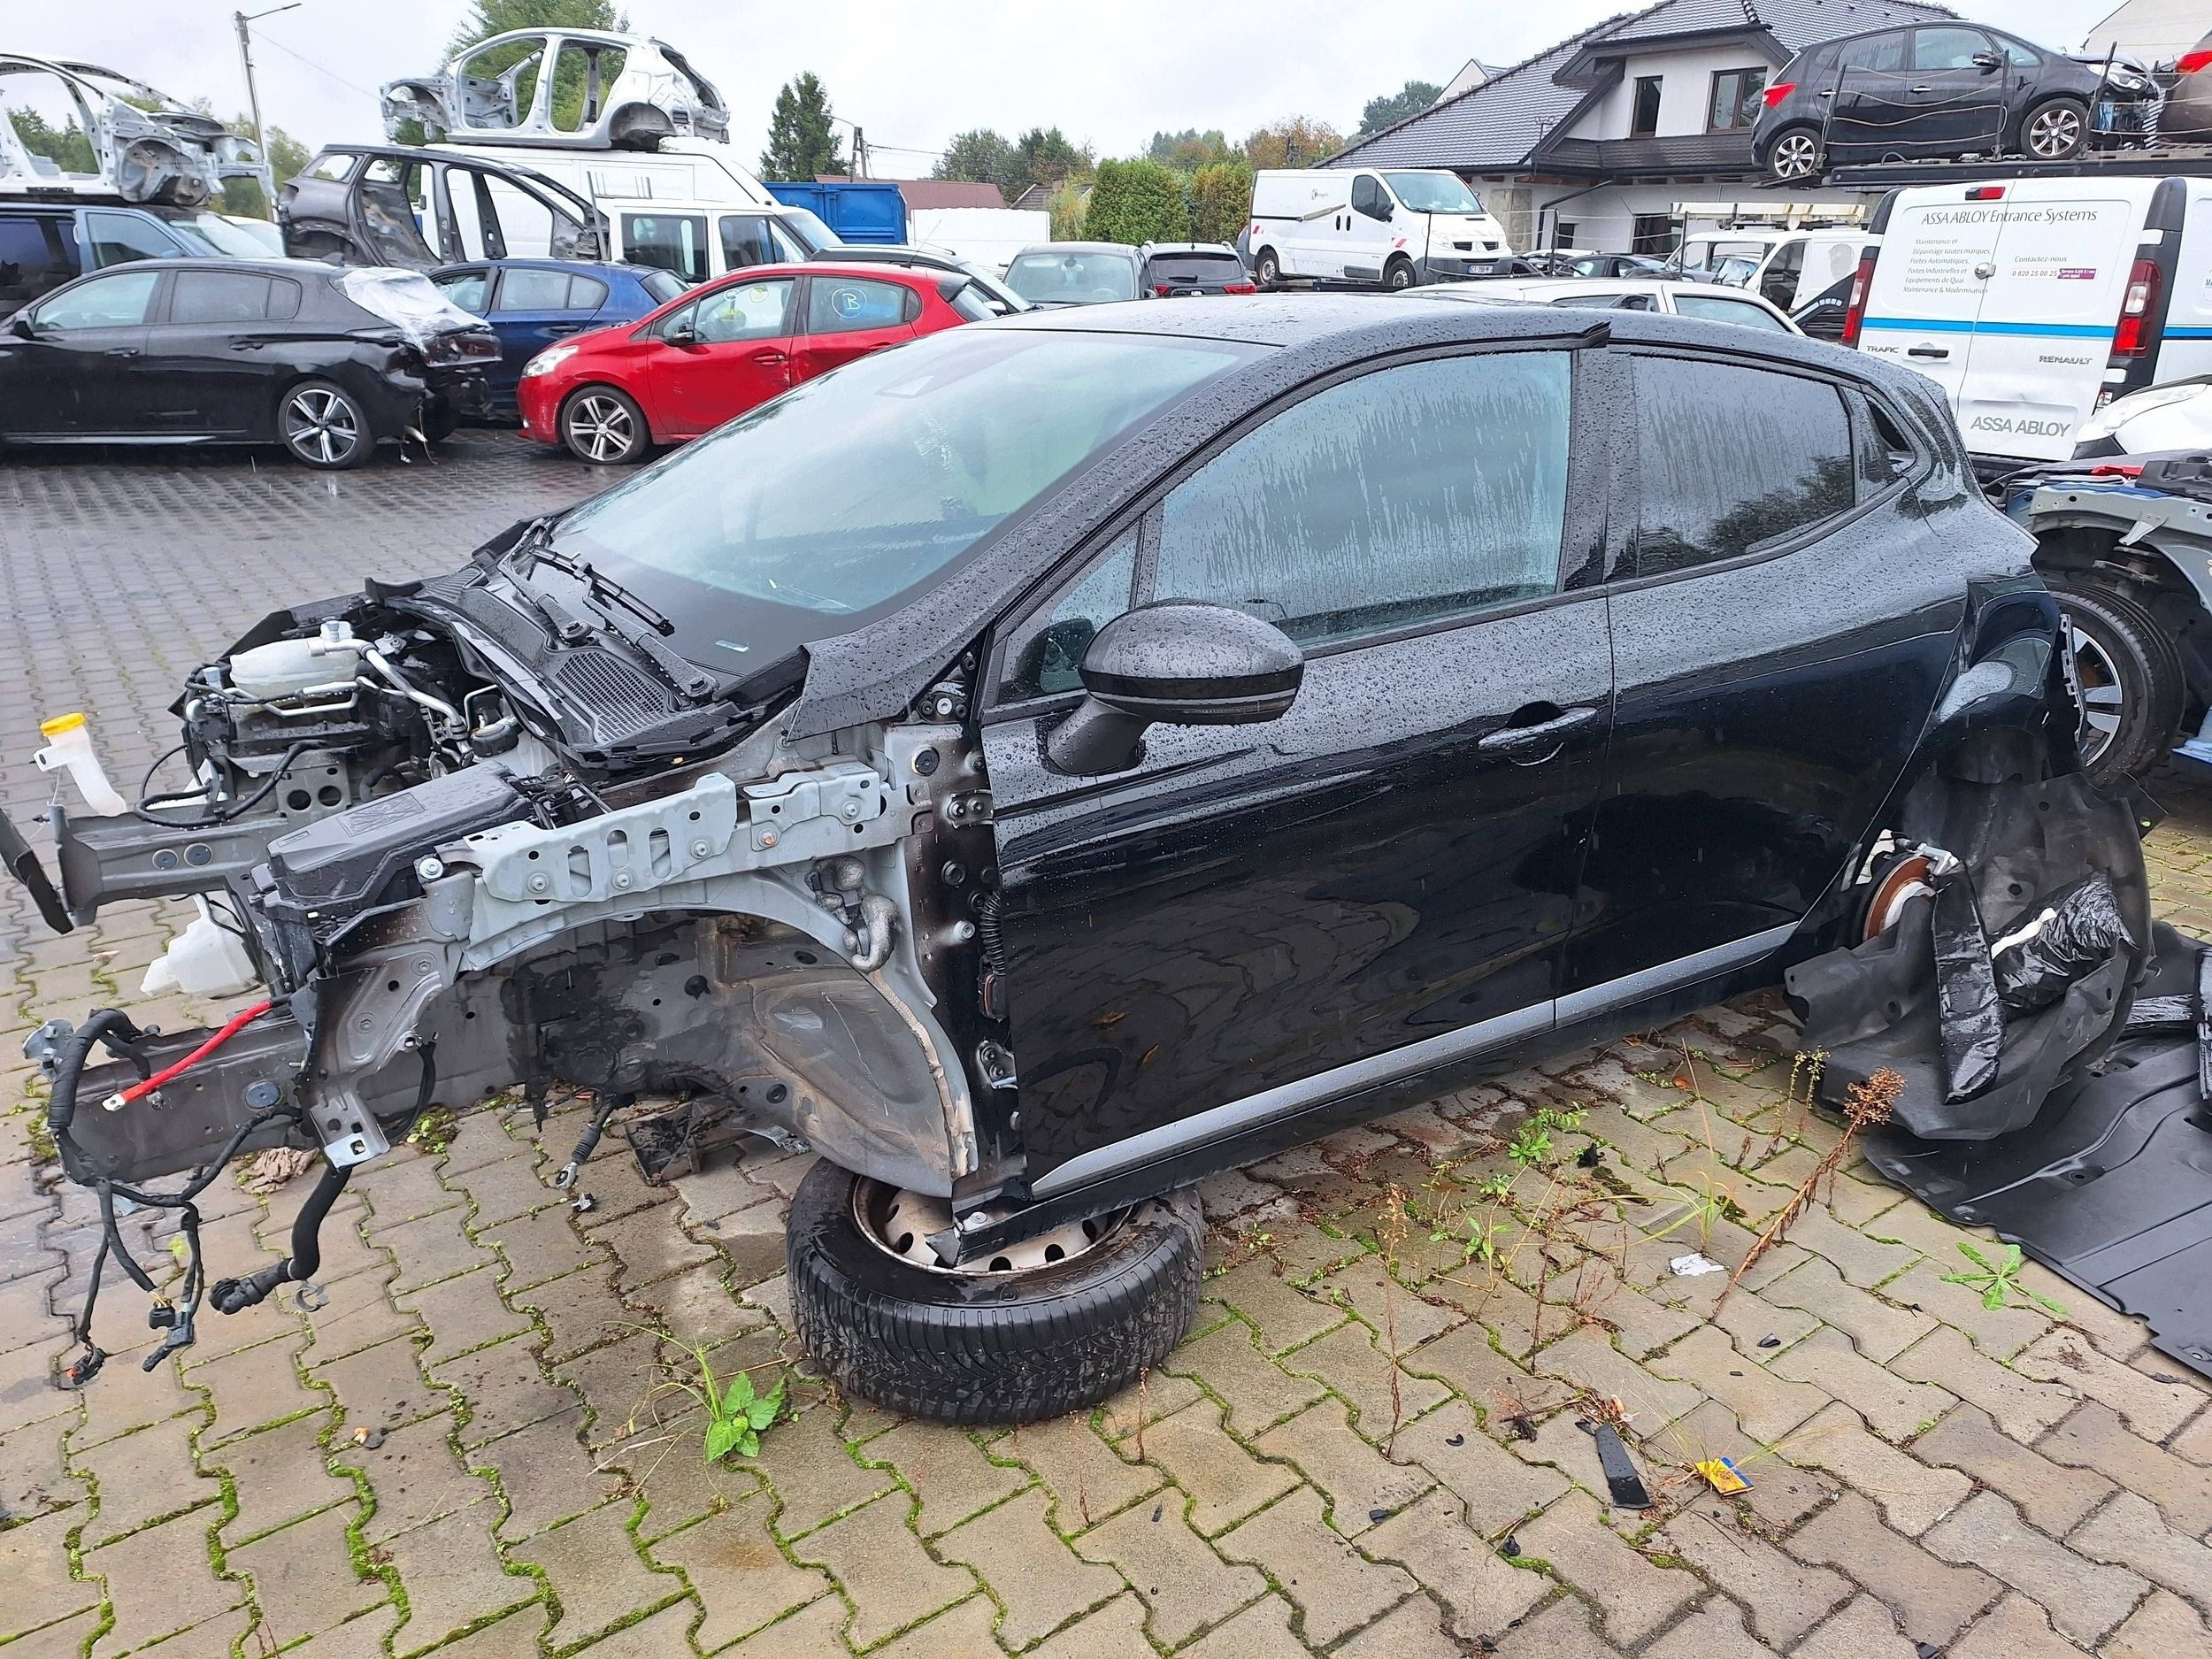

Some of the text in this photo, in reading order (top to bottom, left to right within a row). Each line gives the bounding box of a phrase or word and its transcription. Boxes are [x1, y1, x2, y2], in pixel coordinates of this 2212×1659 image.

[1921, 208, 2098, 226] ASSA ABLOY Entrance Systems
[842, 293, 861, 310] B
[1866, 345, 1900, 354] TRAFIC
[2039, 355, 2093, 365] RENAULT
[1970, 416, 2072, 437] ASSA ABLOY
